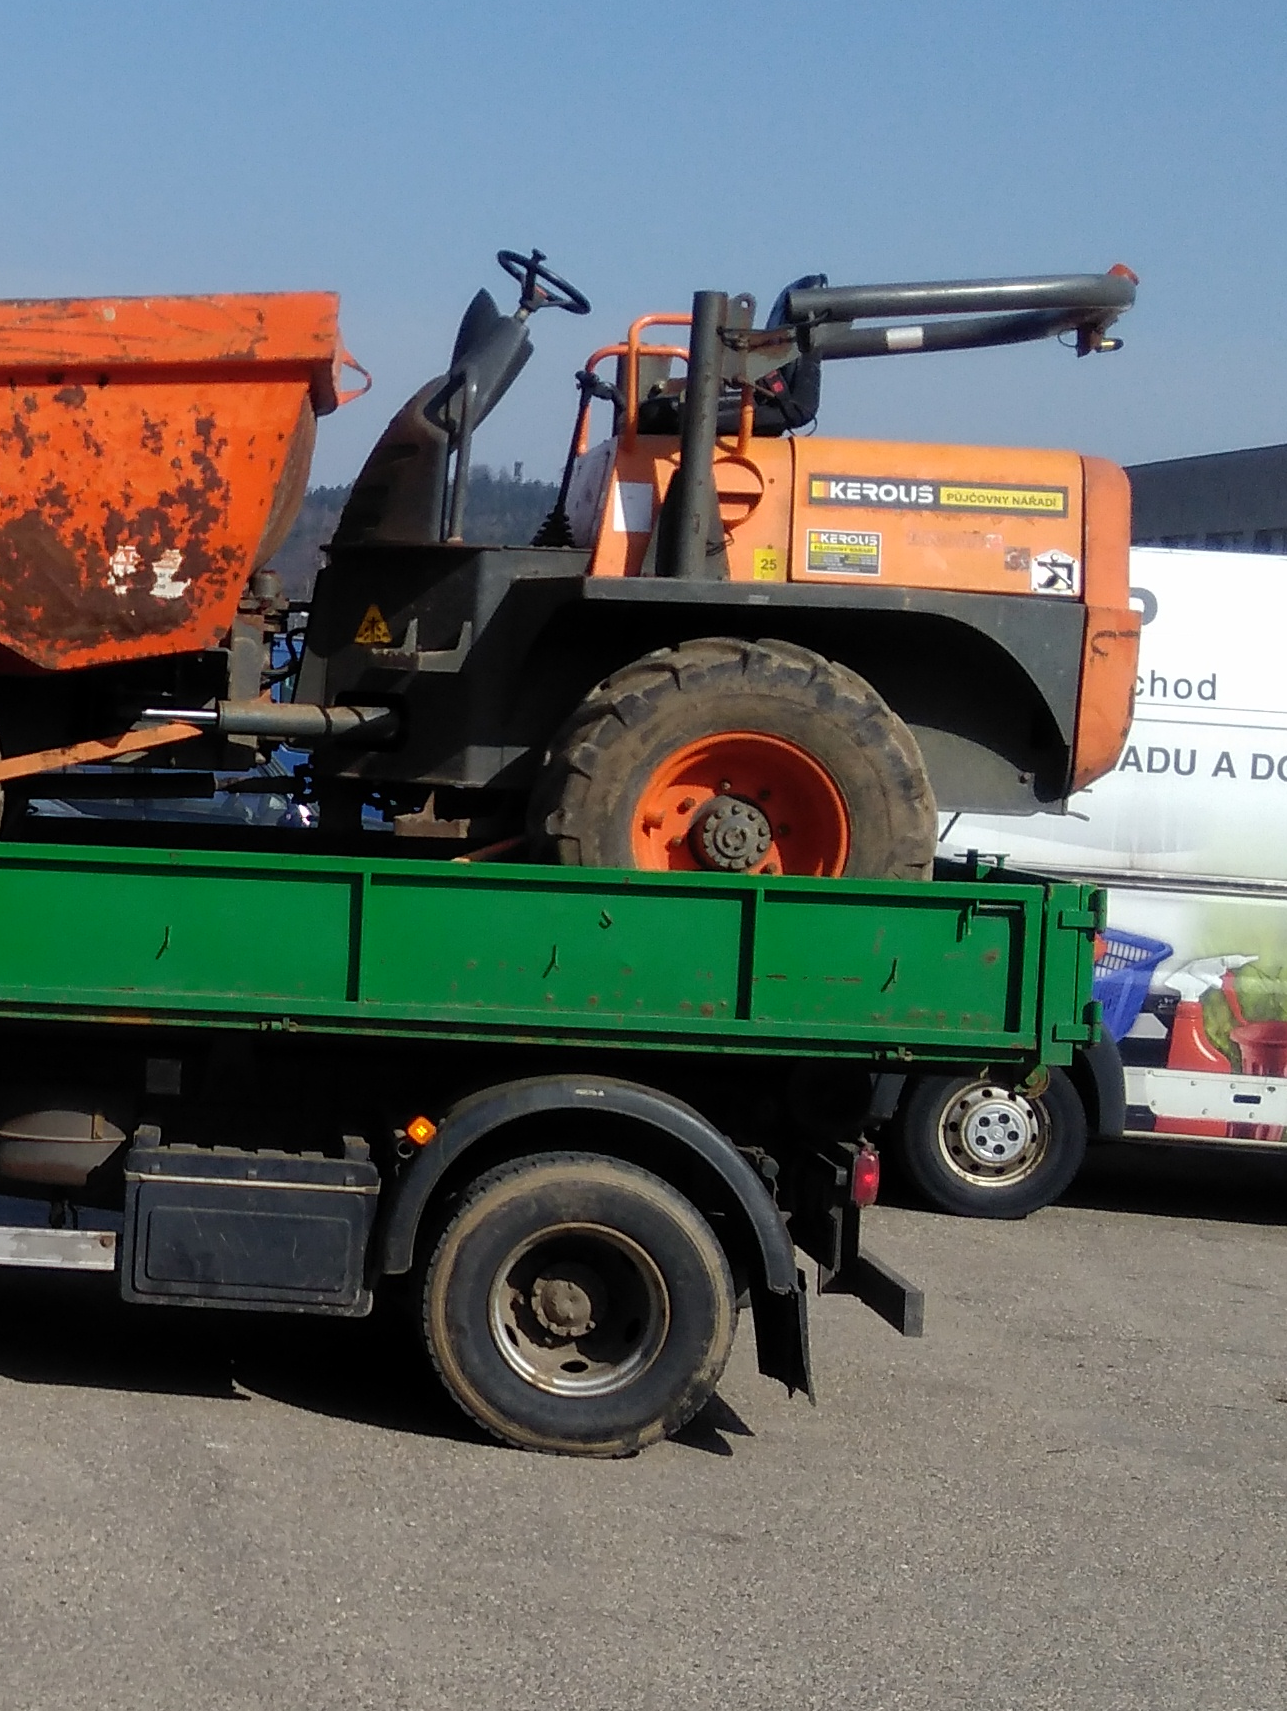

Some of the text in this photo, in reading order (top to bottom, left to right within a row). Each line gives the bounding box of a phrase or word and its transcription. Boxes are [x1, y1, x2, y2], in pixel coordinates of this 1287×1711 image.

[760, 558, 777, 571] 25
[1113, 745, 1197, 776] ADU
[1211, 751, 1237, 779] A
